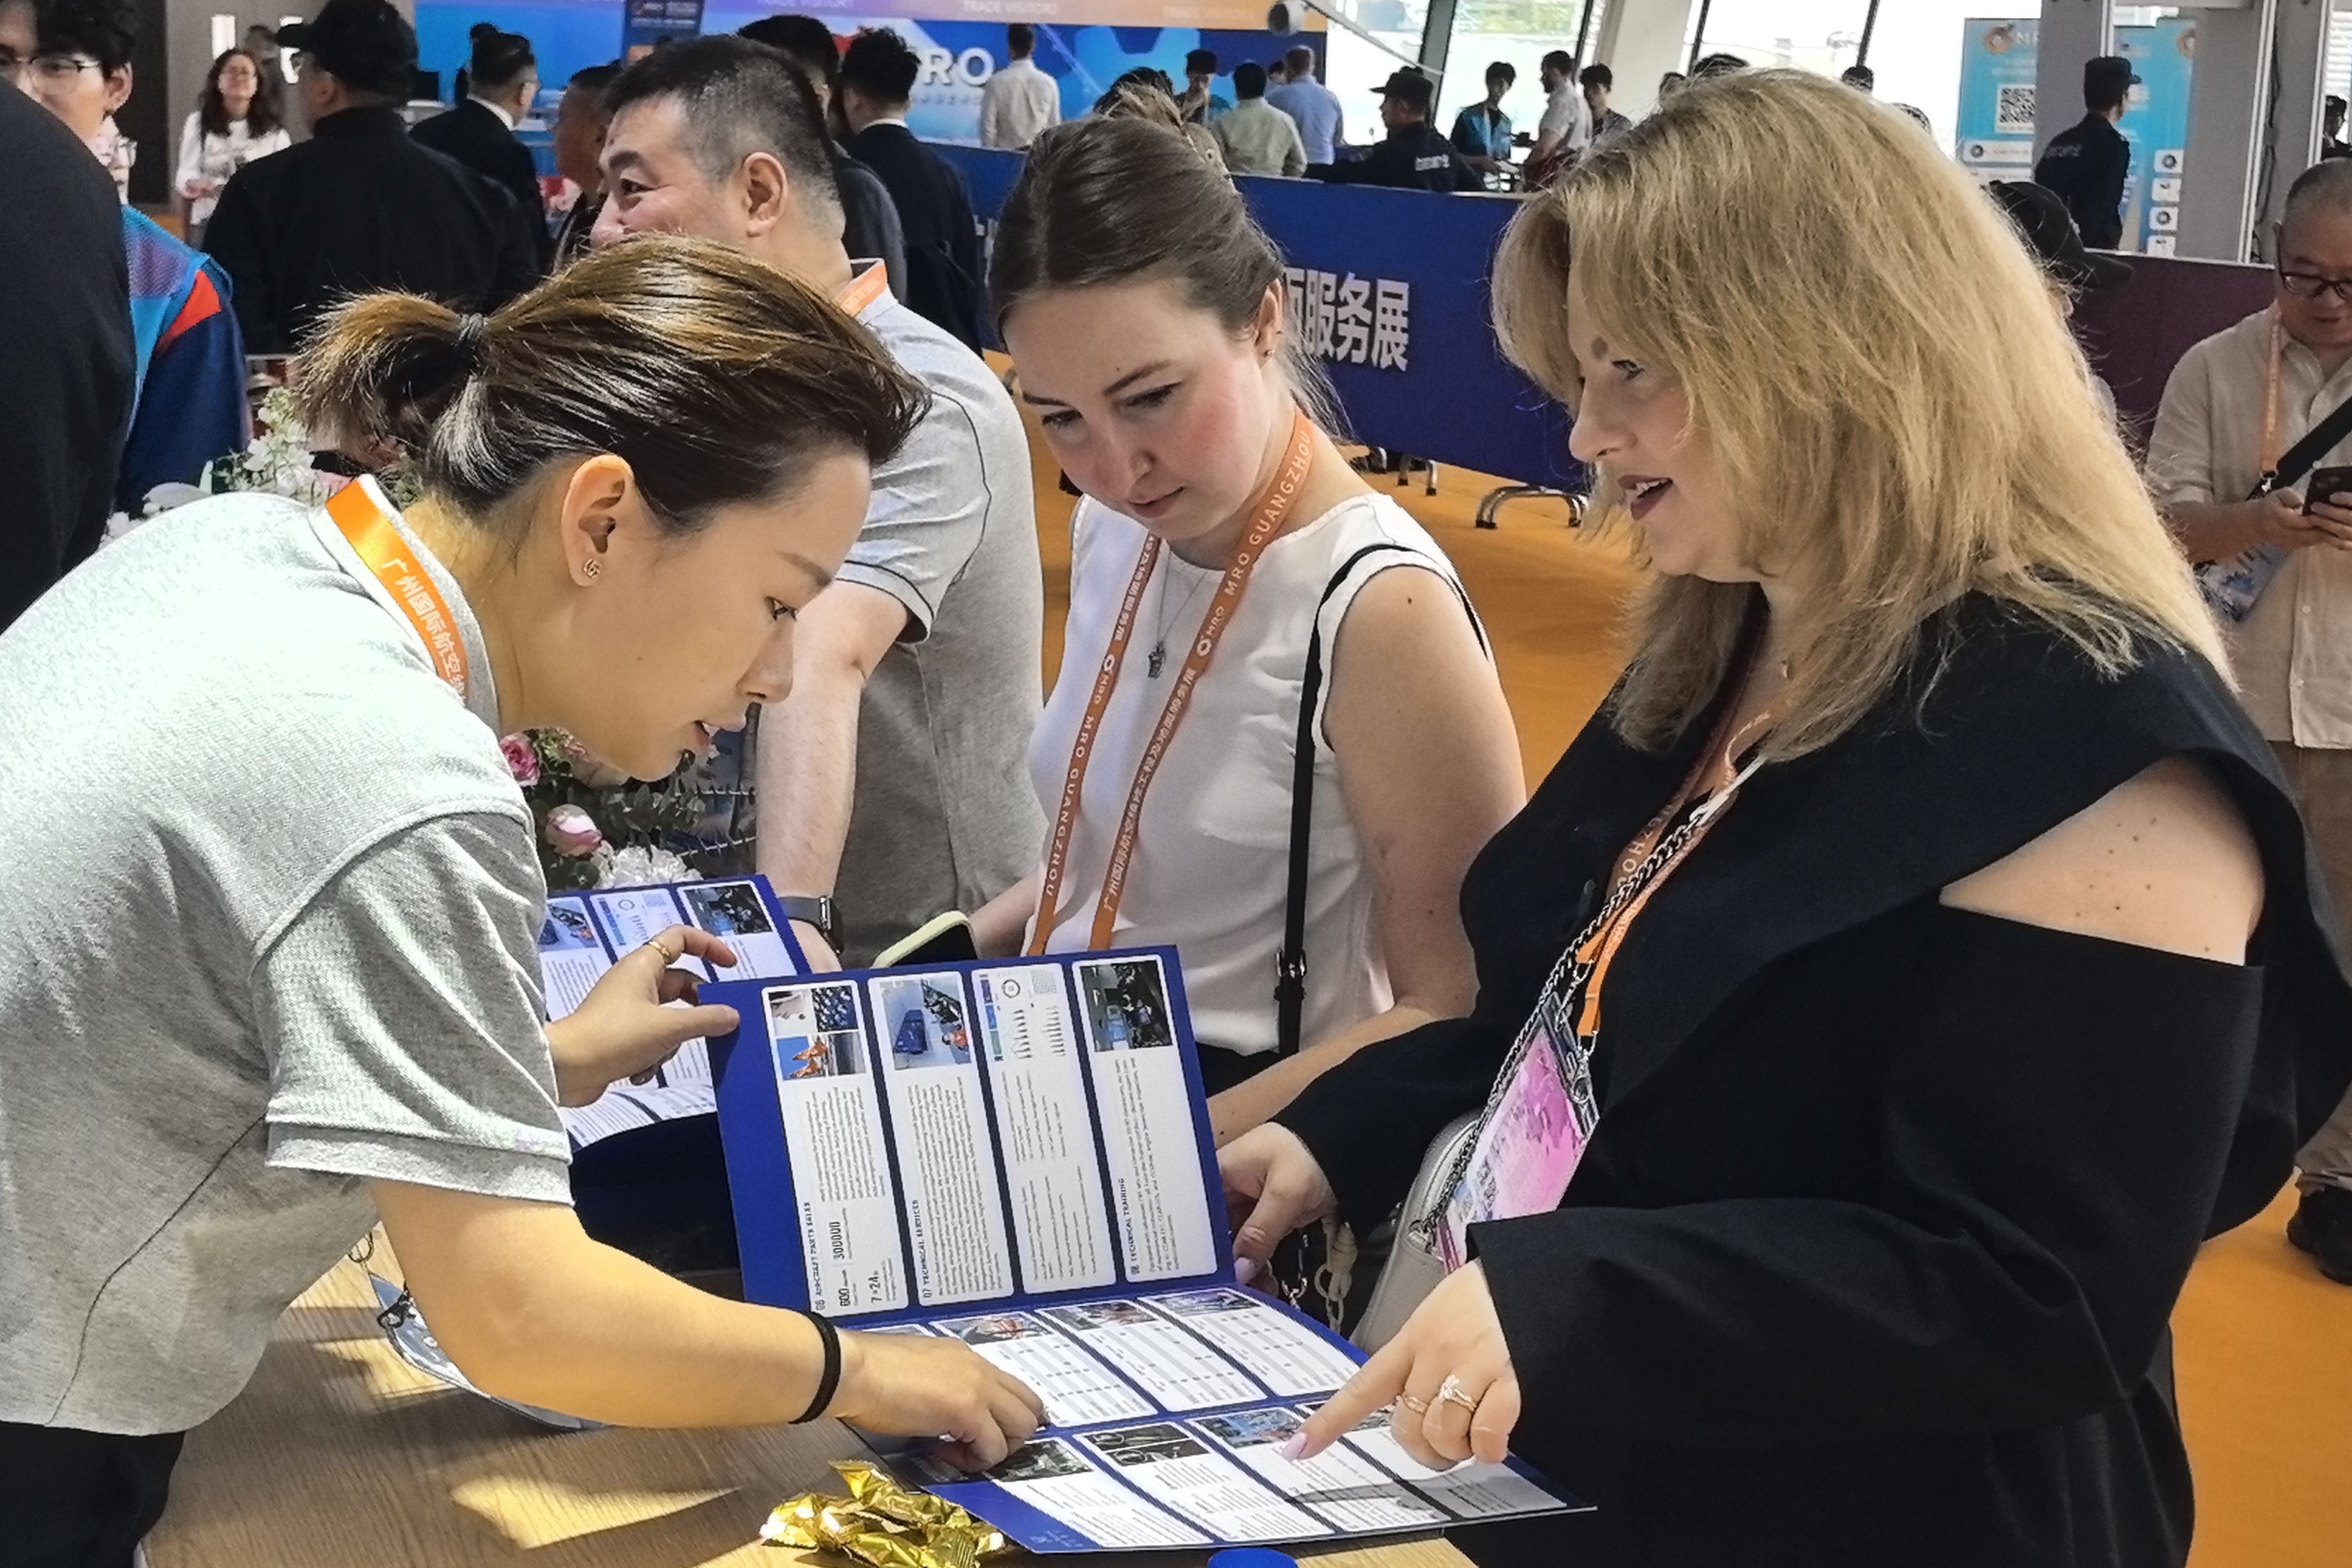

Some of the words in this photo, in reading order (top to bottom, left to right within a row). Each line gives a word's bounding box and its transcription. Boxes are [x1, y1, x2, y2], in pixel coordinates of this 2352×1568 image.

[1224, 553, 1250, 596] MRO
[1249, 430, 1311, 545] GUANGZHOU
[381, 558, 465, 700] 广州国际航空维
[1076, 716, 1094, 758] MRO
[1046, 769, 1079, 896] GUANGZHOU
[1118, 1178, 1130, 1216] TRAINING
[1125, 1217, 1137, 1262] TECHNICAL
[918, 1240, 930, 1286] TECHNICAL
[922, 1288, 932, 1298] 07
